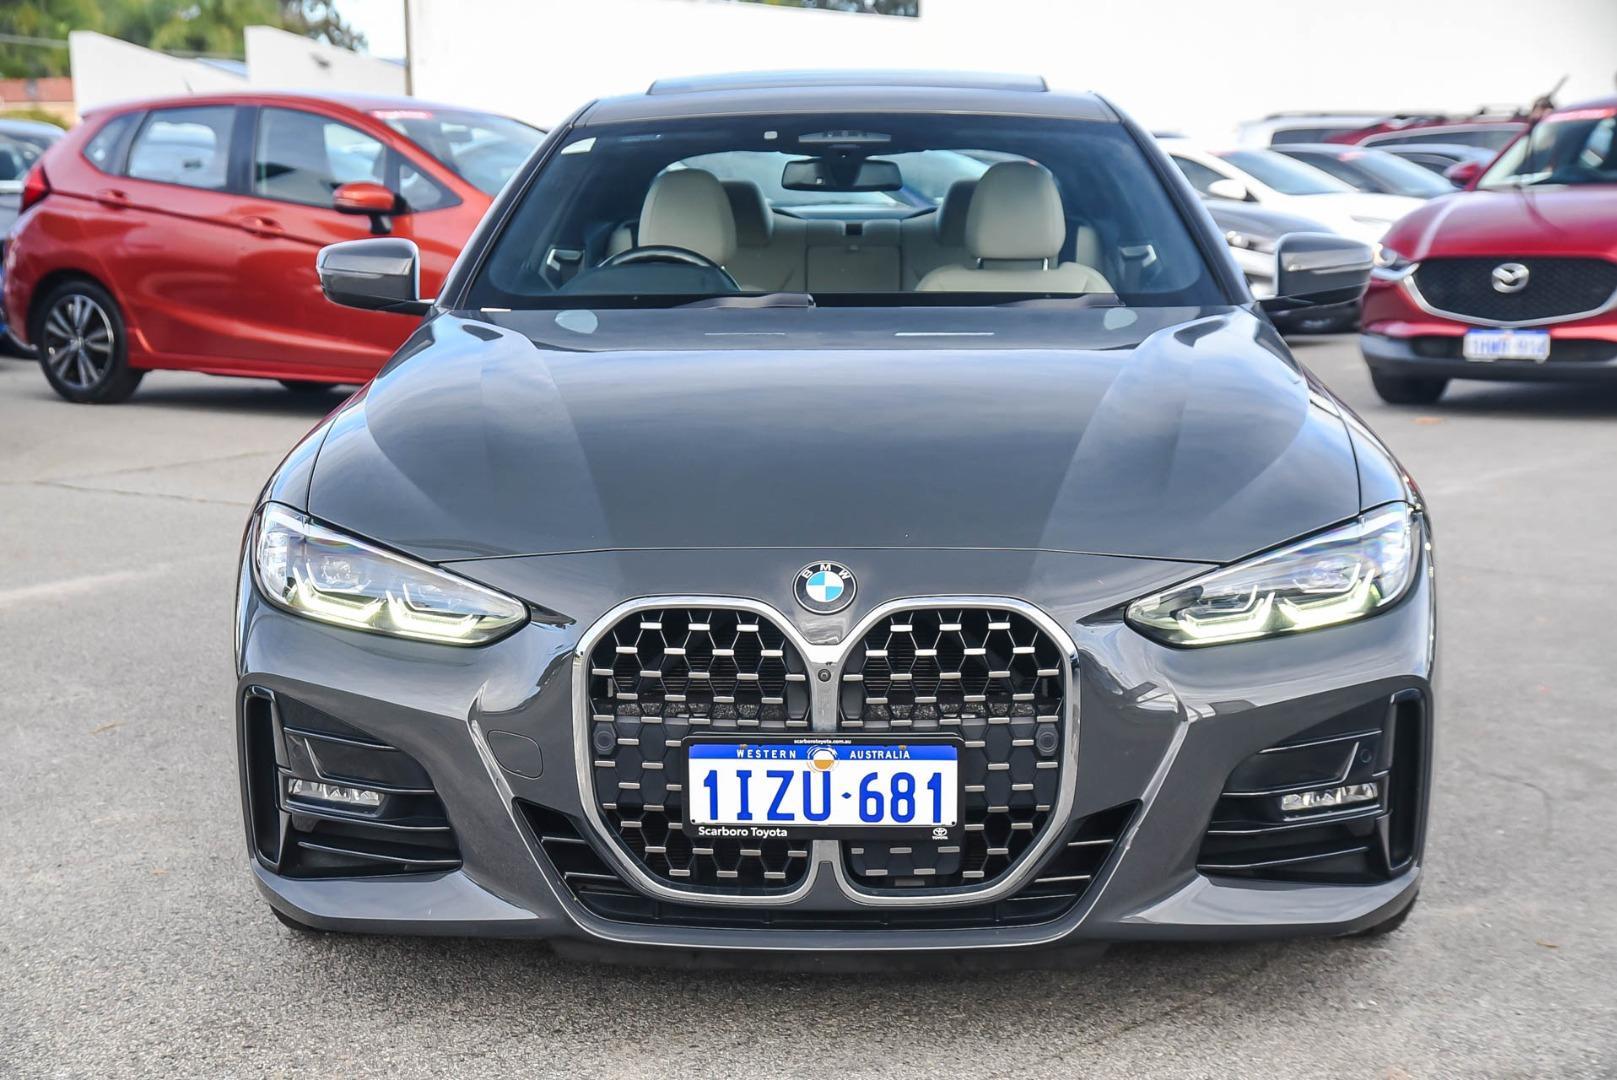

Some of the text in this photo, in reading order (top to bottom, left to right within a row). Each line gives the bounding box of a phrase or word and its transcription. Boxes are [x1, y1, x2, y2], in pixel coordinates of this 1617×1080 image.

[802, 564, 851, 580] BMW
[736, 749, 911, 760] WESTERN AUSTRALIA
[698, 826, 788, 838] Scarboro Toyota
